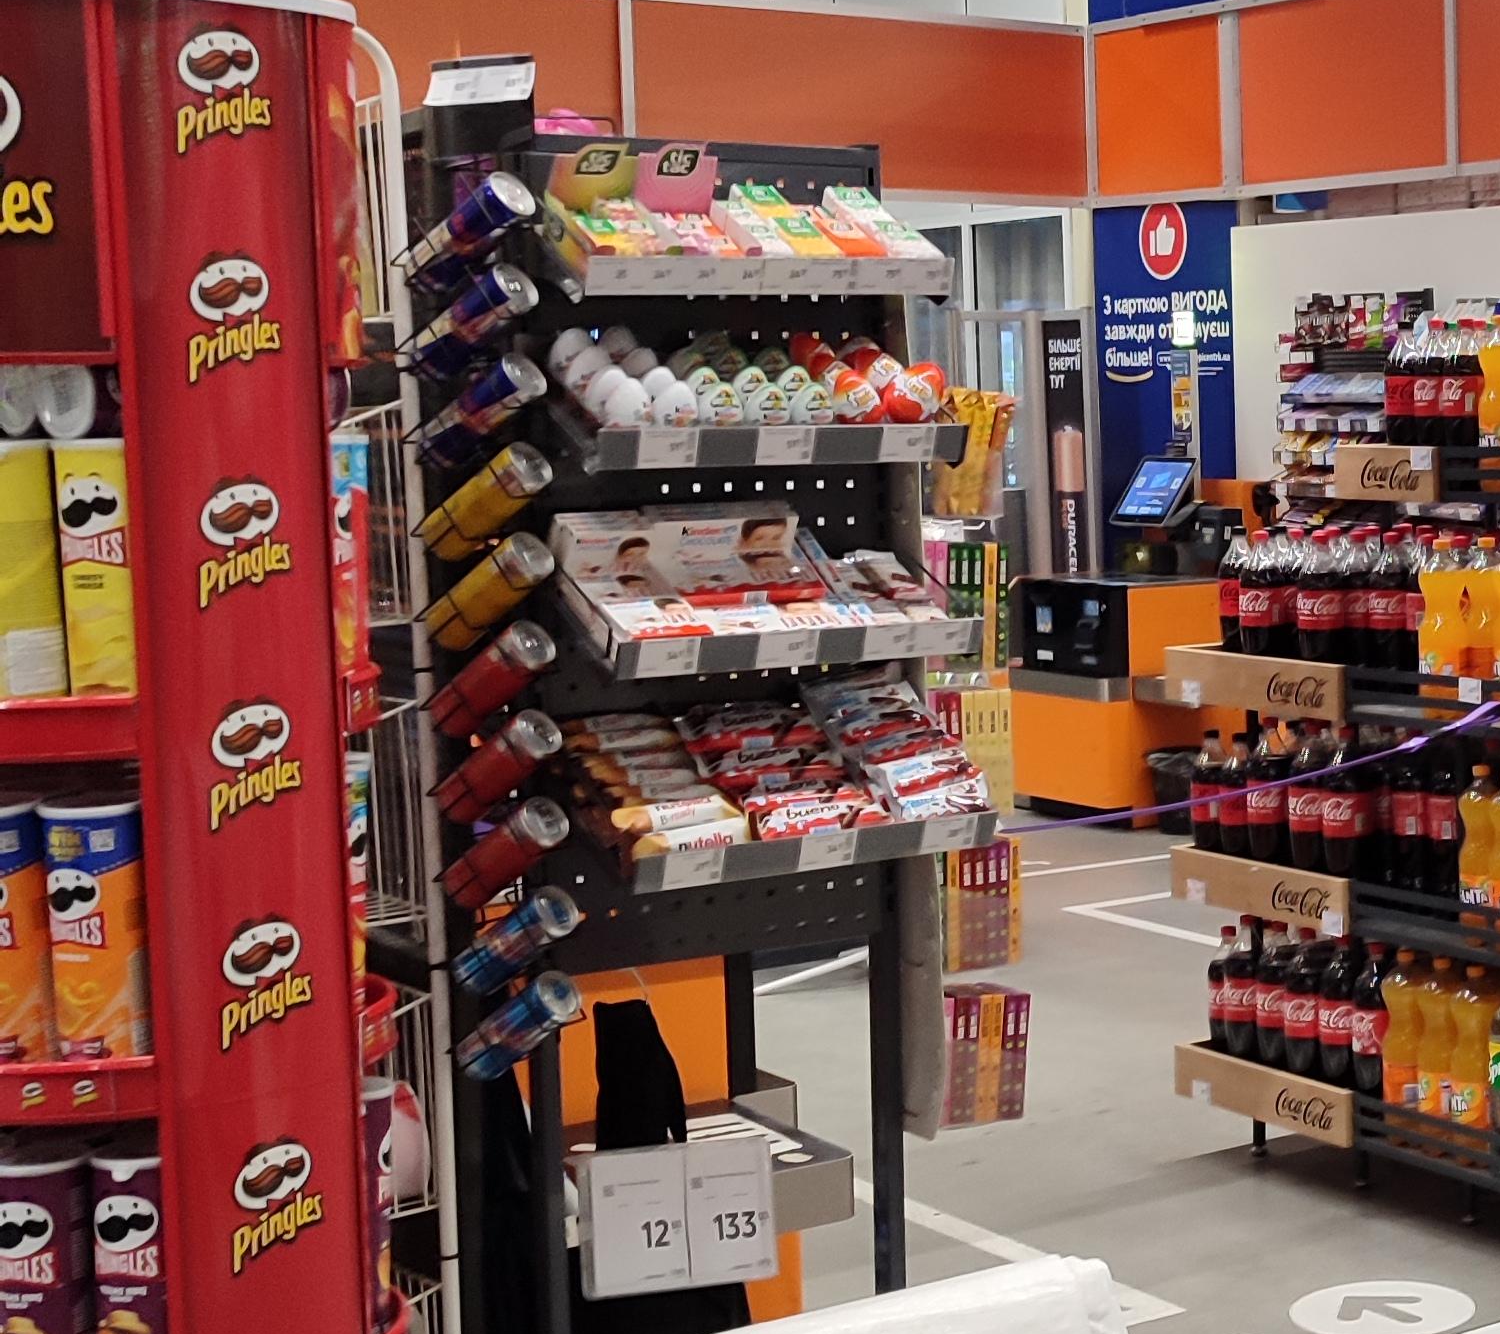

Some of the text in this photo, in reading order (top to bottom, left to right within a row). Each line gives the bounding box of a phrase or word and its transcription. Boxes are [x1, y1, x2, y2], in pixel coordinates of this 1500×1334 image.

[177, 87, 271, 155] Pringles
[1103, 289, 1228, 320] З карткою ВИГОДА
[189, 314, 280, 383] Pringles
[1105, 321, 1230, 345] завжди отмуєш
[1105, 346, 1153, 368] більше!
[199, 537, 291, 608] Pringles
[738, 747, 794, 765] bueno
[211, 756, 301, 831] Pringles
[785, 802, 840, 820] bueno
[678, 833, 734, 853] nutella
[222, 973, 312, 1050] Pringles
[1275, 1088, 1336, 1130] Coca-Cola
[233, 1192, 323, 1274] Pringles
[641, 1219, 671, 1248] 12
[712, 1211, 758, 1241] 133
